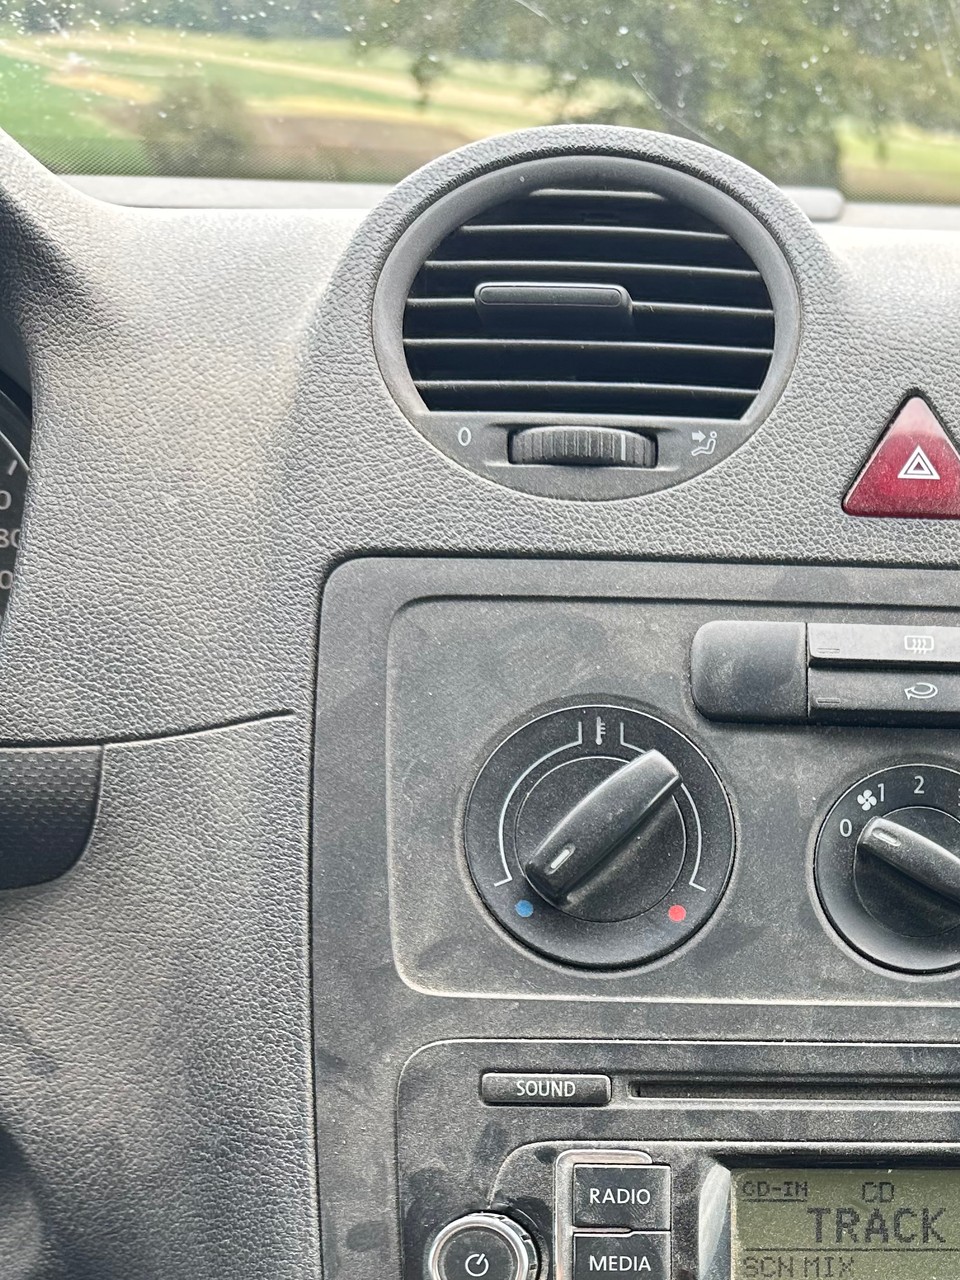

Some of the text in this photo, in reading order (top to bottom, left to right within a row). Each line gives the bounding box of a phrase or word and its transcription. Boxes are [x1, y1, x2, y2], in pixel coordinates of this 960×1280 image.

[839, 818, 853, 838] 0
[877, 783, 885, 802] 1
[913, 775, 925, 795] 2
[515, 1079, 577, 1099] SOUND
[588, 1187, 652, 1206] RADIO
[742, 1180, 809, 1197] CD-IN
[861, 1181, 895, 1204] CD
[807, 1207, 947, 1244] TRACK
[588, 1255, 652, 1273] MEDIA
[742, 1256, 856, 1278] SCN MIX
